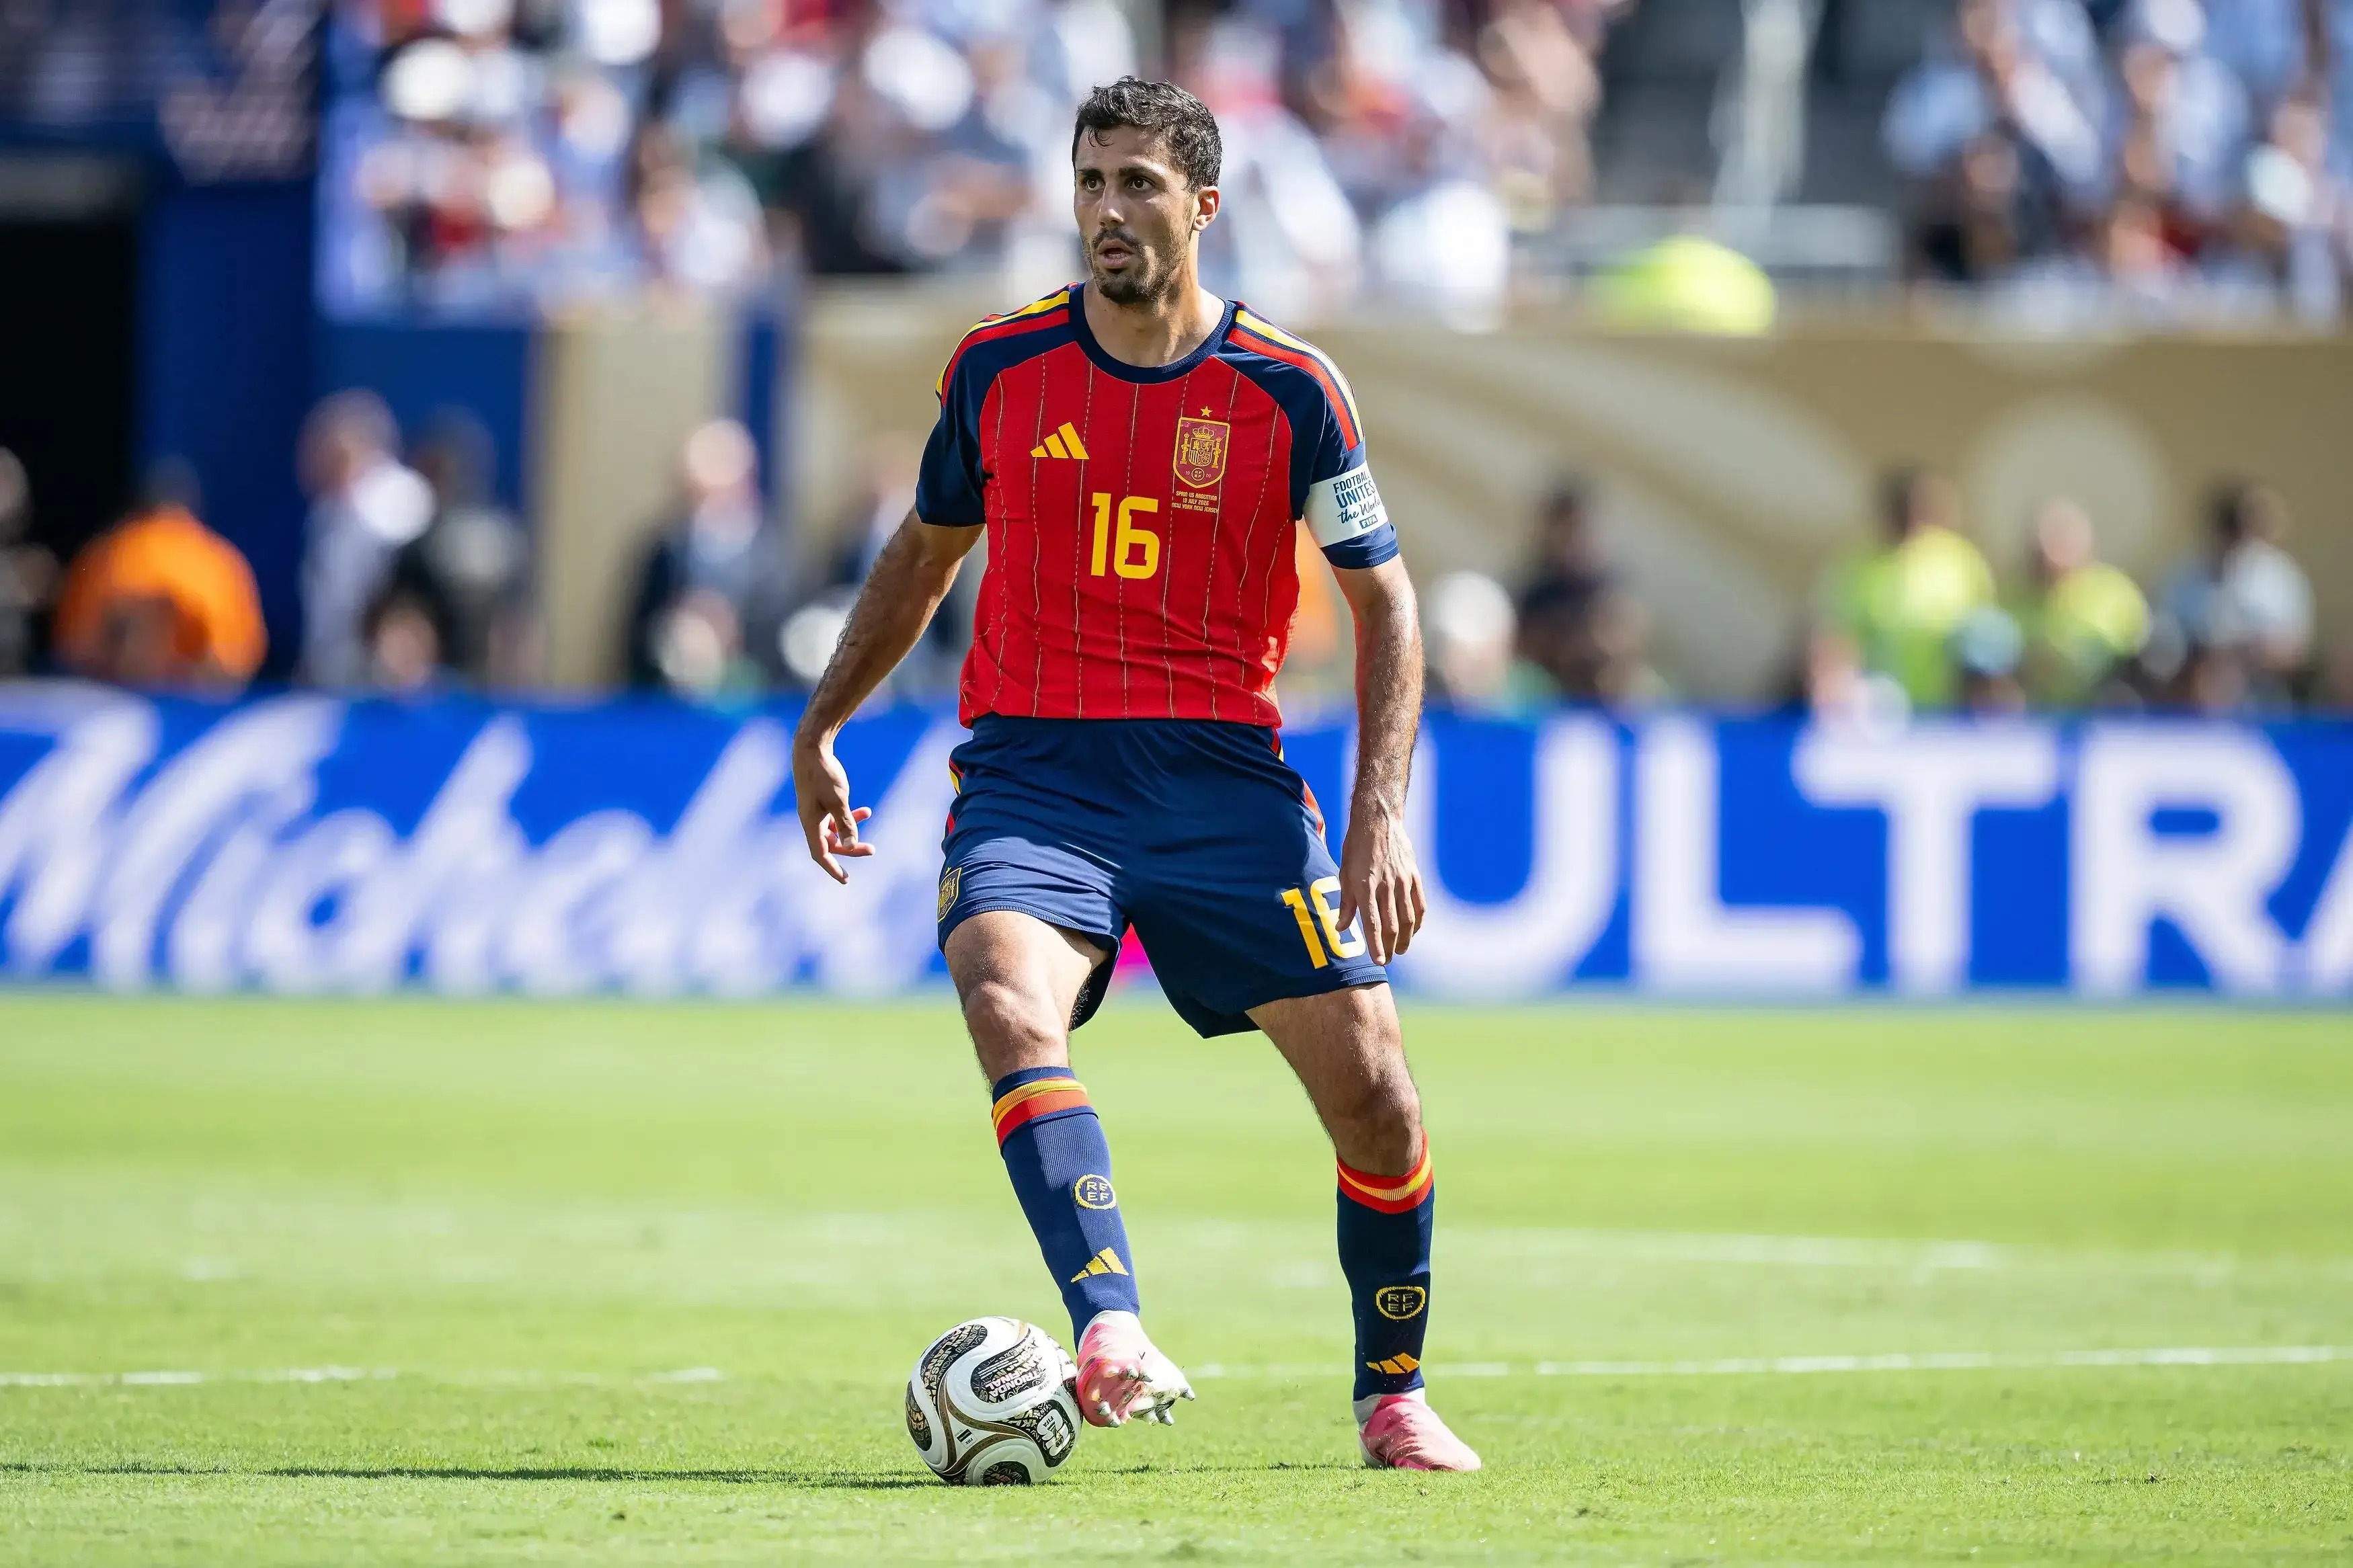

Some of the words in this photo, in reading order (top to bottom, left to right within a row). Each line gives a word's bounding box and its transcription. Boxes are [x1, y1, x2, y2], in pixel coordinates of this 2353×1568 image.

[1336, 480, 1375, 508] UNITES
[1337, 508, 1359, 524] the
[1361, 515, 1377, 528] FIFA
[1091, 492, 1160, 579] 16
[1397, 708, 2353, 999] ULTR
[1281, 876, 1366, 969] 16
[1388, 1293, 1414, 1303] RF
[1388, 1302, 1414, 1312] EF
[928, 1347, 952, 1389] JERSEY
[985, 1370, 1021, 1390] FINAL
[988, 1371, 1040, 1397] TRIONDA
[1043, 1415, 1054, 1428] FIFA
